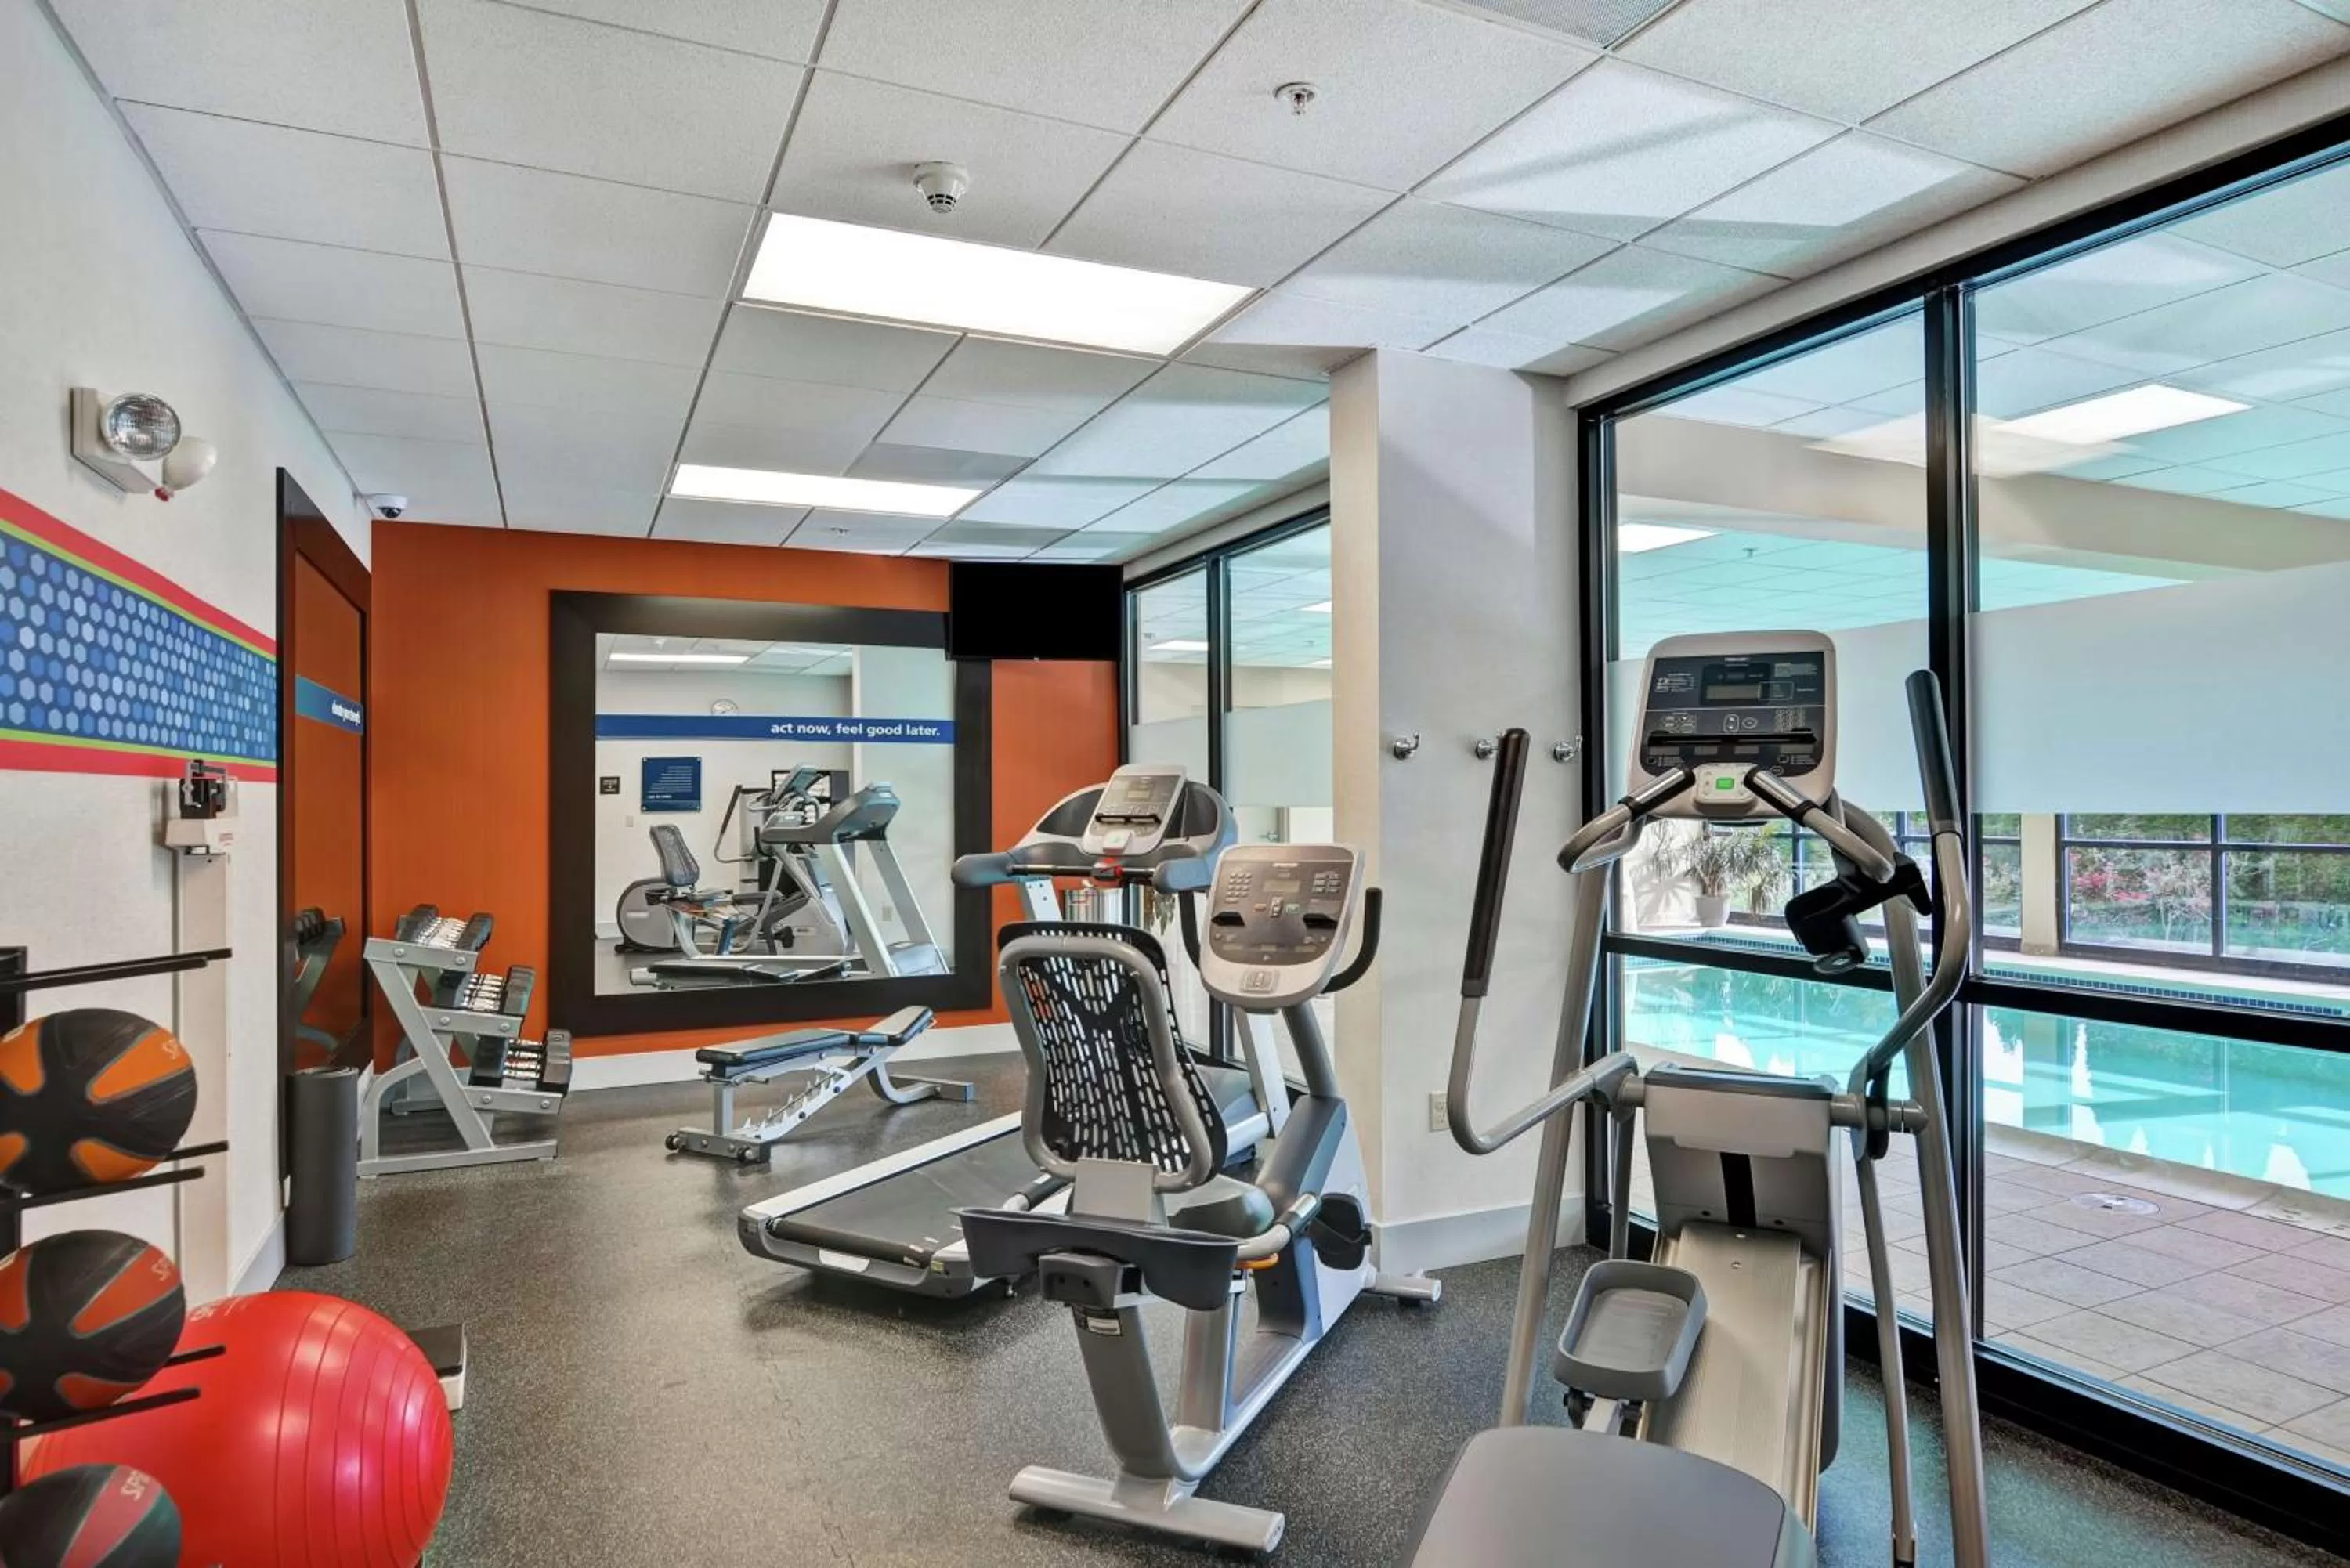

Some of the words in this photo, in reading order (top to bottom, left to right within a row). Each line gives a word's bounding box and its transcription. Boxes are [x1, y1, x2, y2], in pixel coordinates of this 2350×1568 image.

[771, 723, 794, 734] act
[797, 724, 831, 735] now,
[836, 722, 863, 735] feel
[867, 724, 902, 737] good
[906, 724, 940, 736] later.
